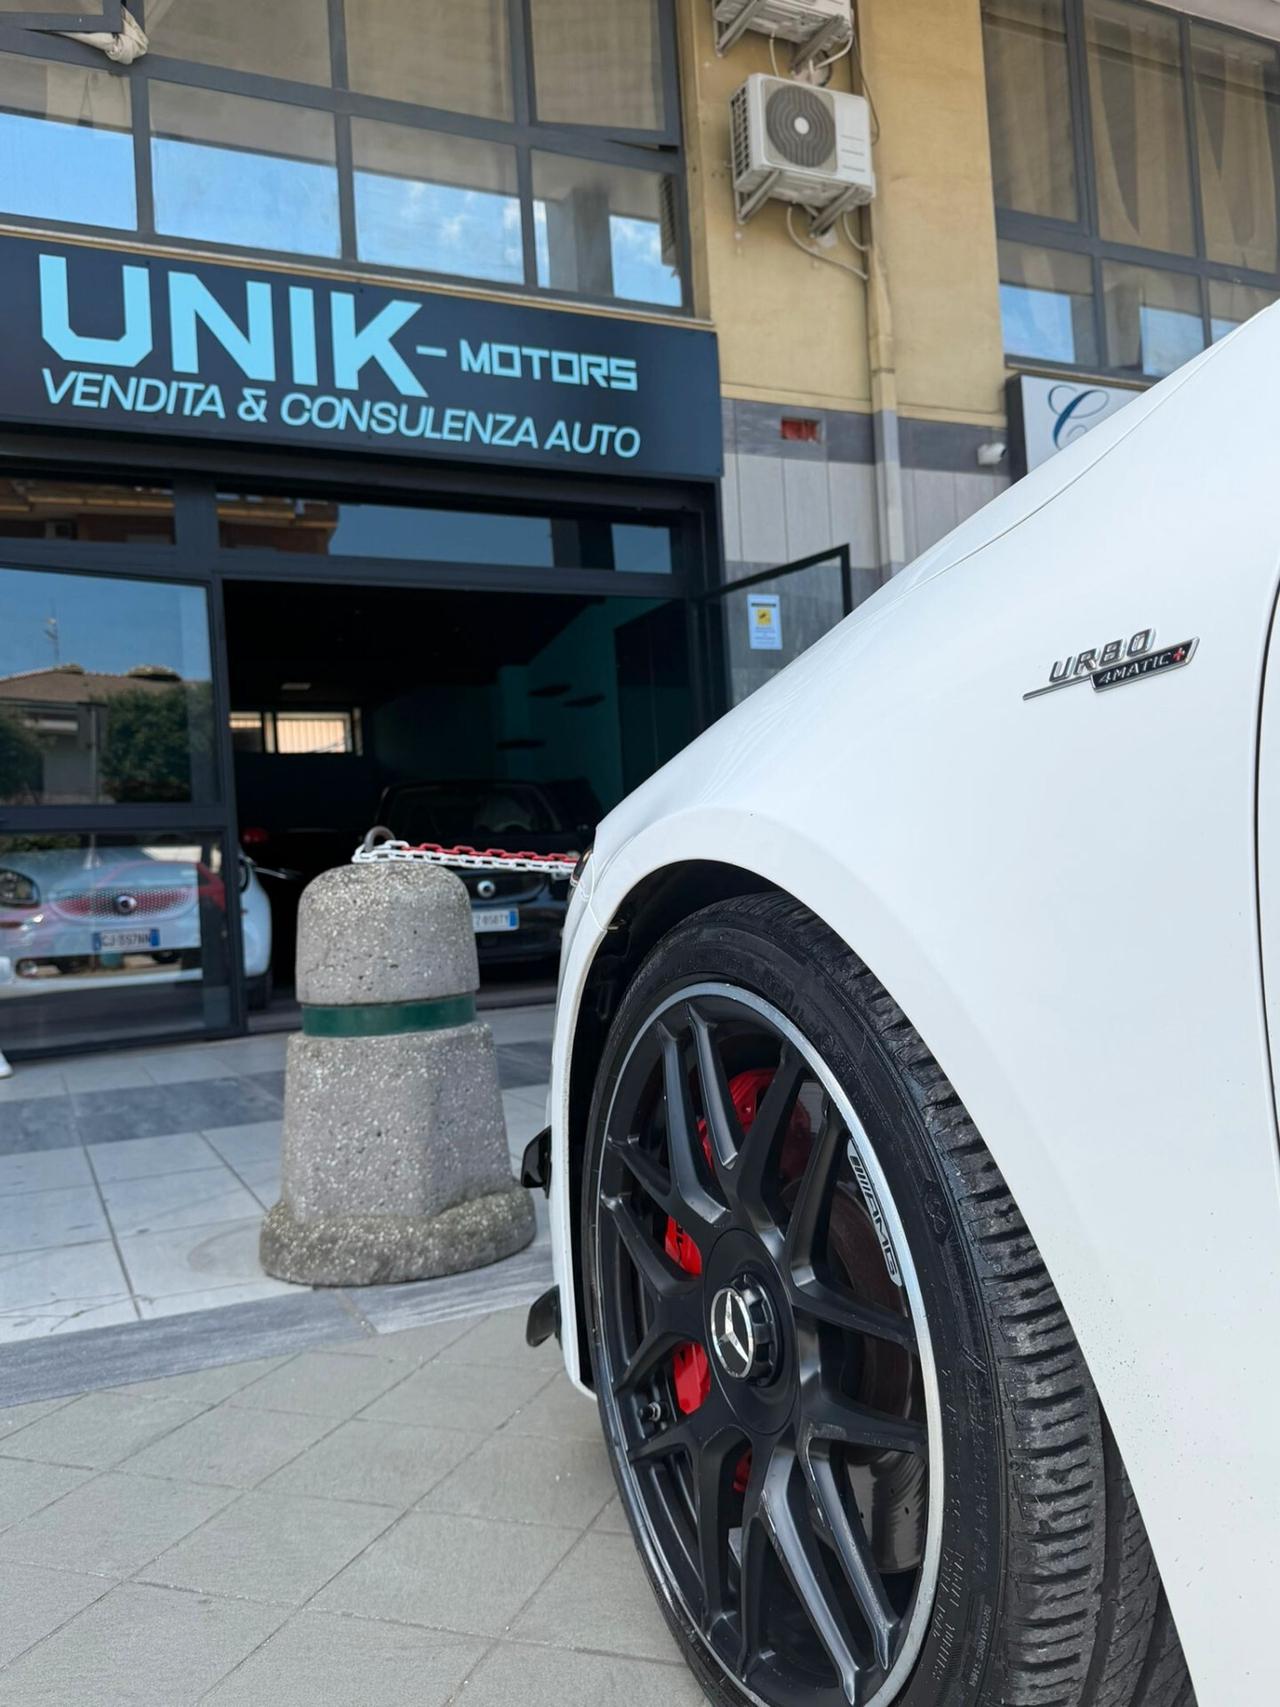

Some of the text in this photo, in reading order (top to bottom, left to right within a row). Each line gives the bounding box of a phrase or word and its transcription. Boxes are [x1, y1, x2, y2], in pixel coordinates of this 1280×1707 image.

[459, 338, 638, 391] MOTORS
[42, 367, 641, 458] VENDITA & CONSULENZA AUTO
